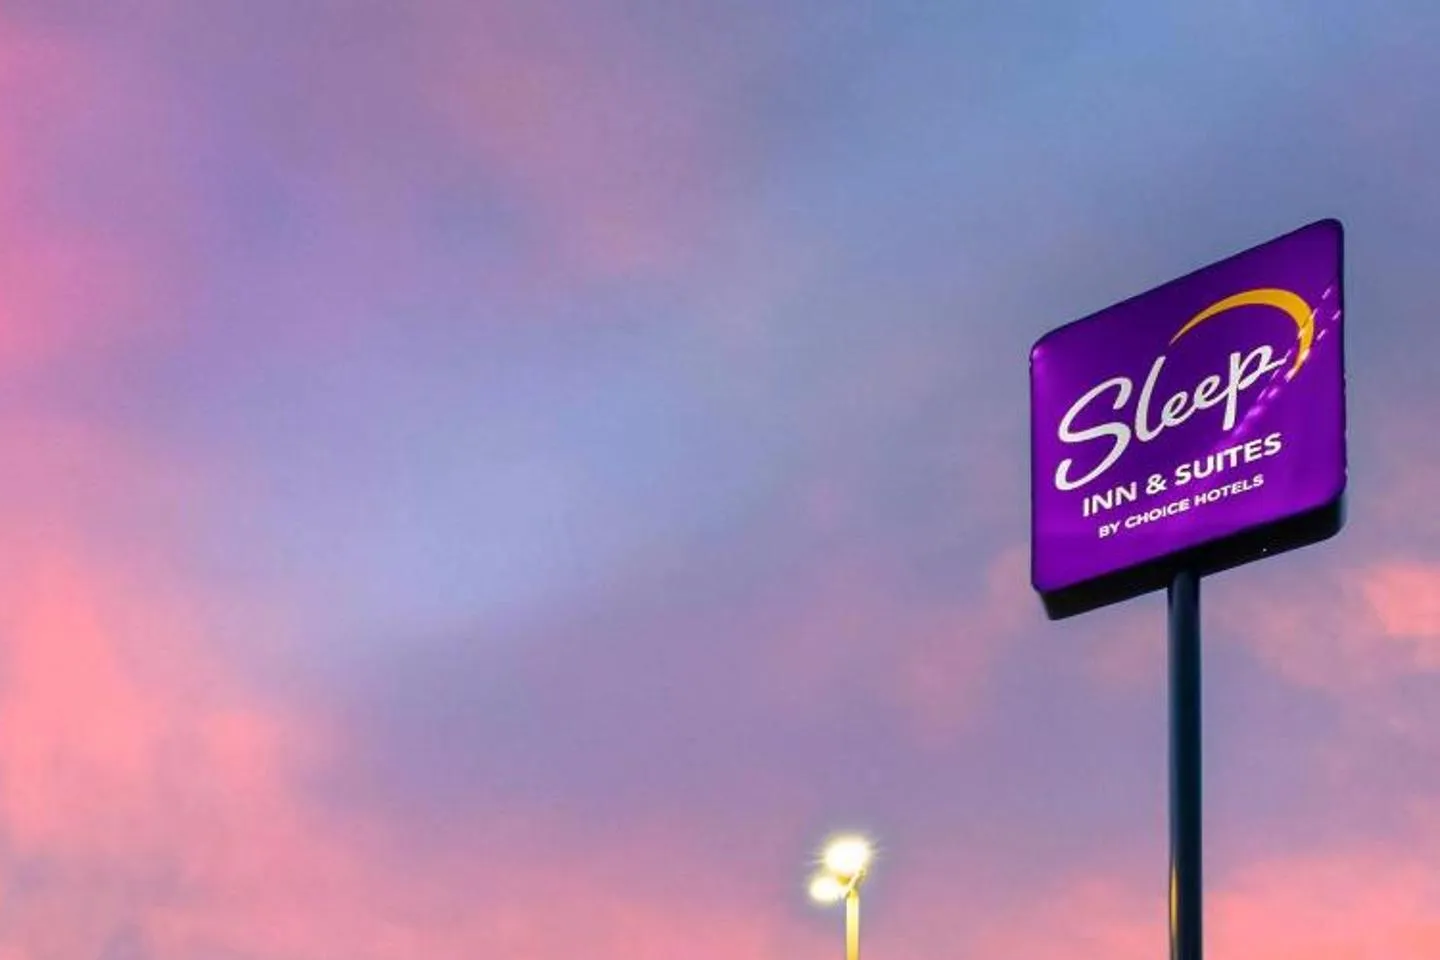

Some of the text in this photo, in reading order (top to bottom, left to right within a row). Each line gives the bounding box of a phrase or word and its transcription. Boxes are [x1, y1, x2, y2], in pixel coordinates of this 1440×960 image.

[1054, 344, 1288, 491] Sleep
[1083, 432, 1282, 517] INN & SUITES
[1098, 474, 1264, 538] BY CHOICE HOTELS
